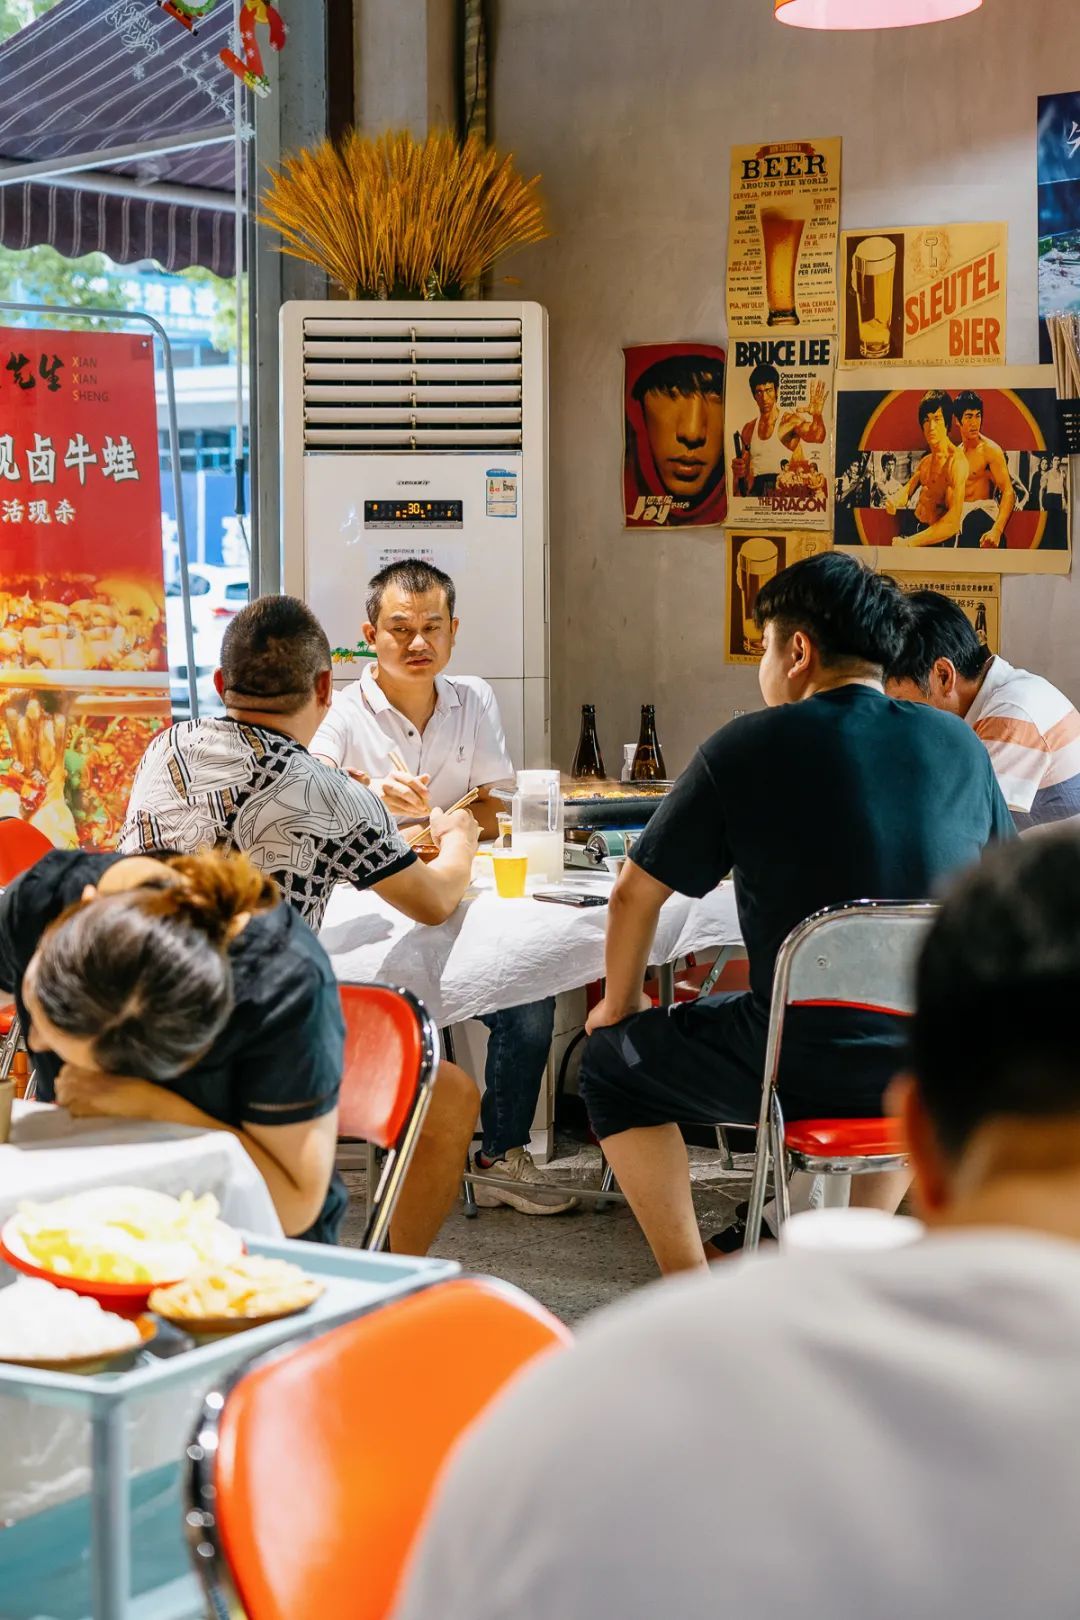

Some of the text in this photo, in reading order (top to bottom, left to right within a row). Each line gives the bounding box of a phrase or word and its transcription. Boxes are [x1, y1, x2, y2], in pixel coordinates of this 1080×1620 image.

[741, 155, 828, 181] BEER
[740, 177, 828, 190] AROUND THE WORLD
[905, 252, 1000, 336] SLEUTEL
[949, 318, 1001, 357] BIER
[735, 339, 831, 368] BRUCE LEE
[72, 356, 98, 368] XIAN
[72, 373, 98, 385] XIAN
[72, 390, 109, 402] SHENG
[407, 502, 421, 515] 30
[757, 497, 827, 513] THE DRAGON
